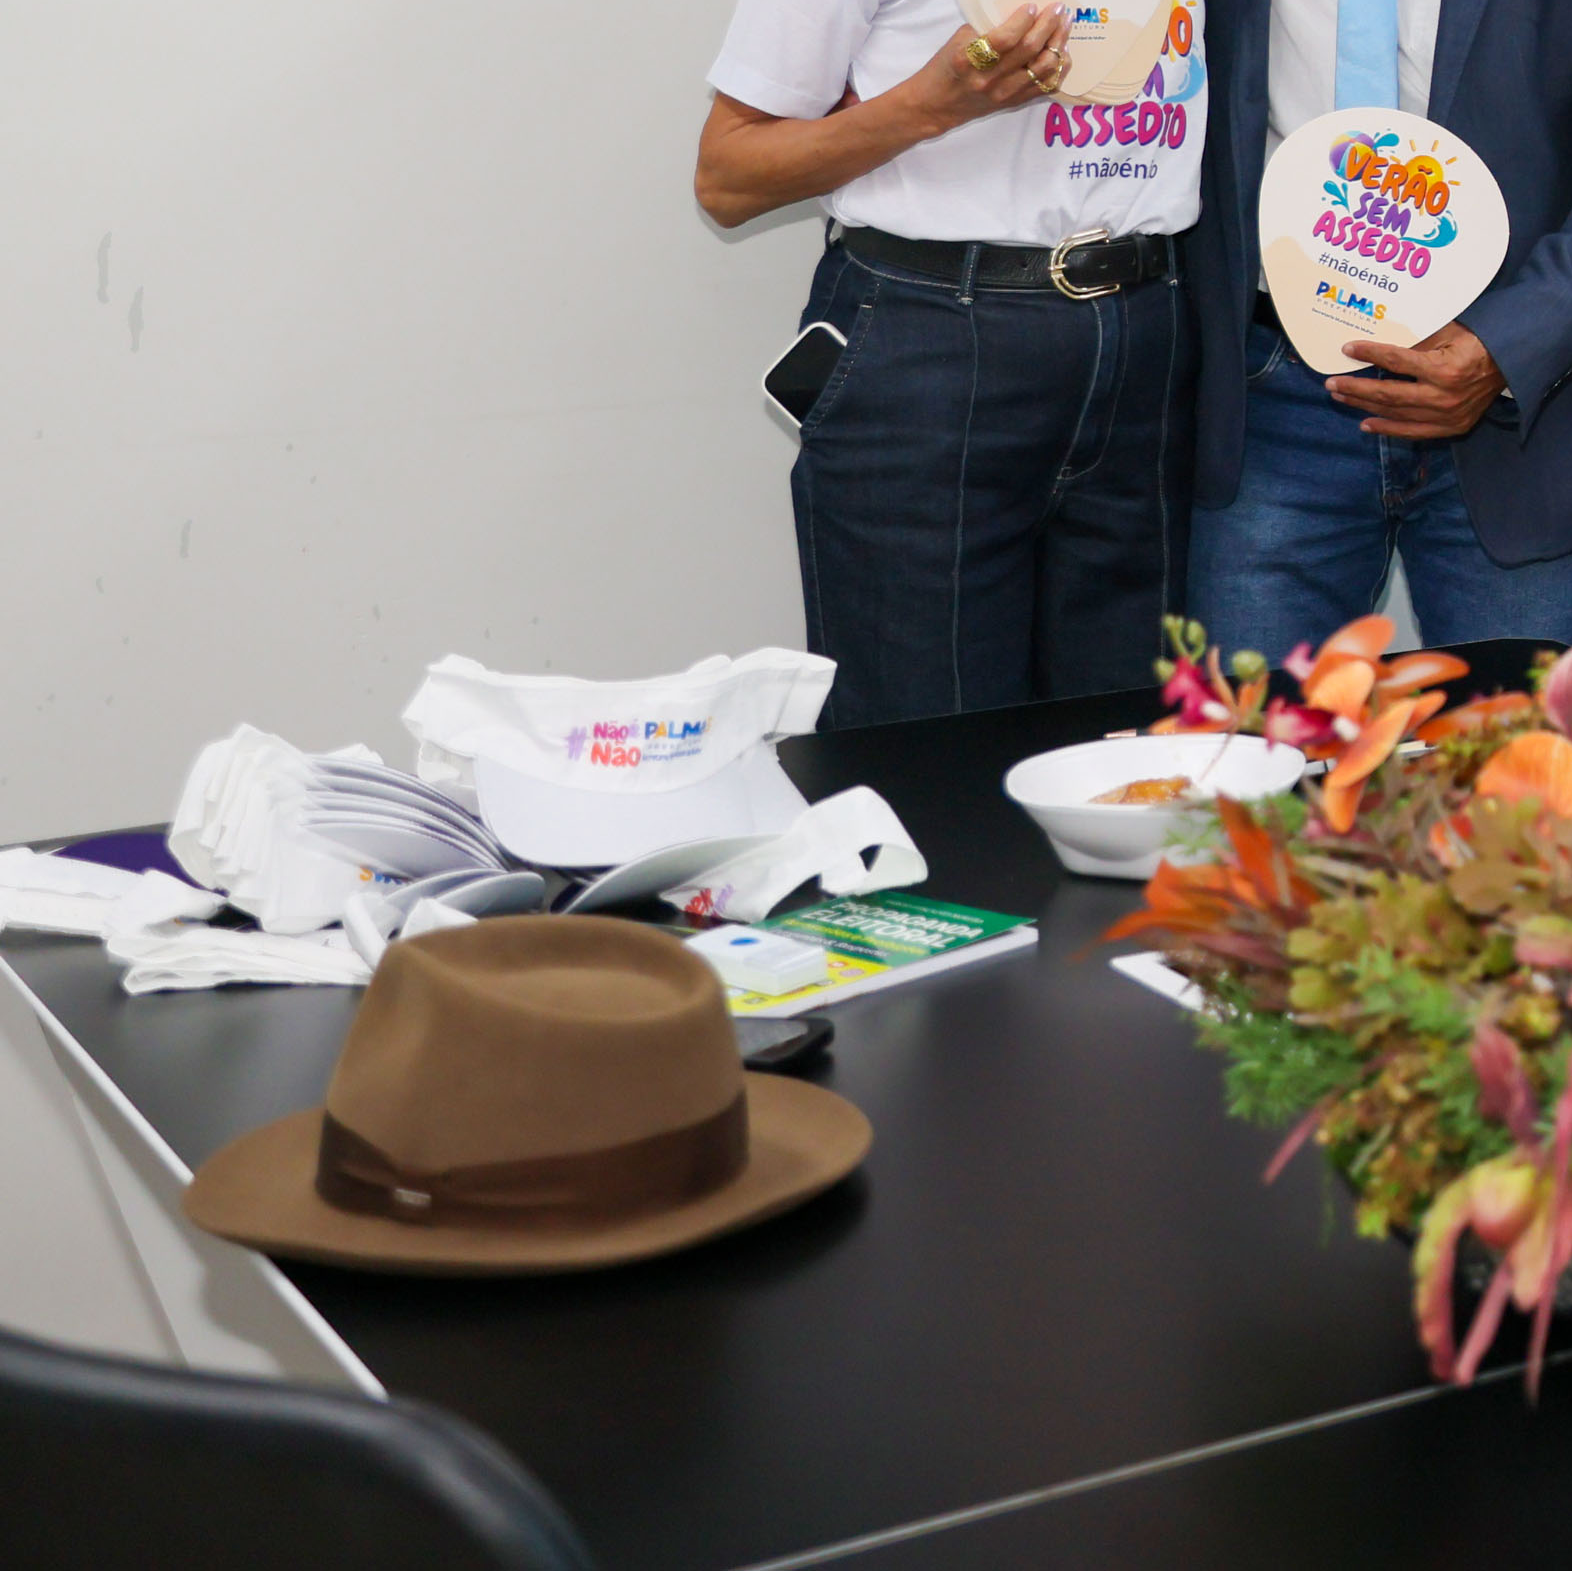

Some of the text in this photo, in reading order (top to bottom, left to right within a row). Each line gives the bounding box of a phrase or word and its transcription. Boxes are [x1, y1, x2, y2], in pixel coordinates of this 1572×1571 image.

[1067, 8, 1109, 23] MAS
[1345, 146, 1450, 216] VERÃO
[1353, 191, 1411, 238] SEM
[1318, 251, 1399, 293] #nãoénão
[1316, 281, 1387, 320] PALMAS
[593, 720, 629, 740] Não
[591, 740, 641, 767] Não
[801, 909, 956, 950] ELEITORAL
[831, 902, 984, 939] PROPAGANDA
